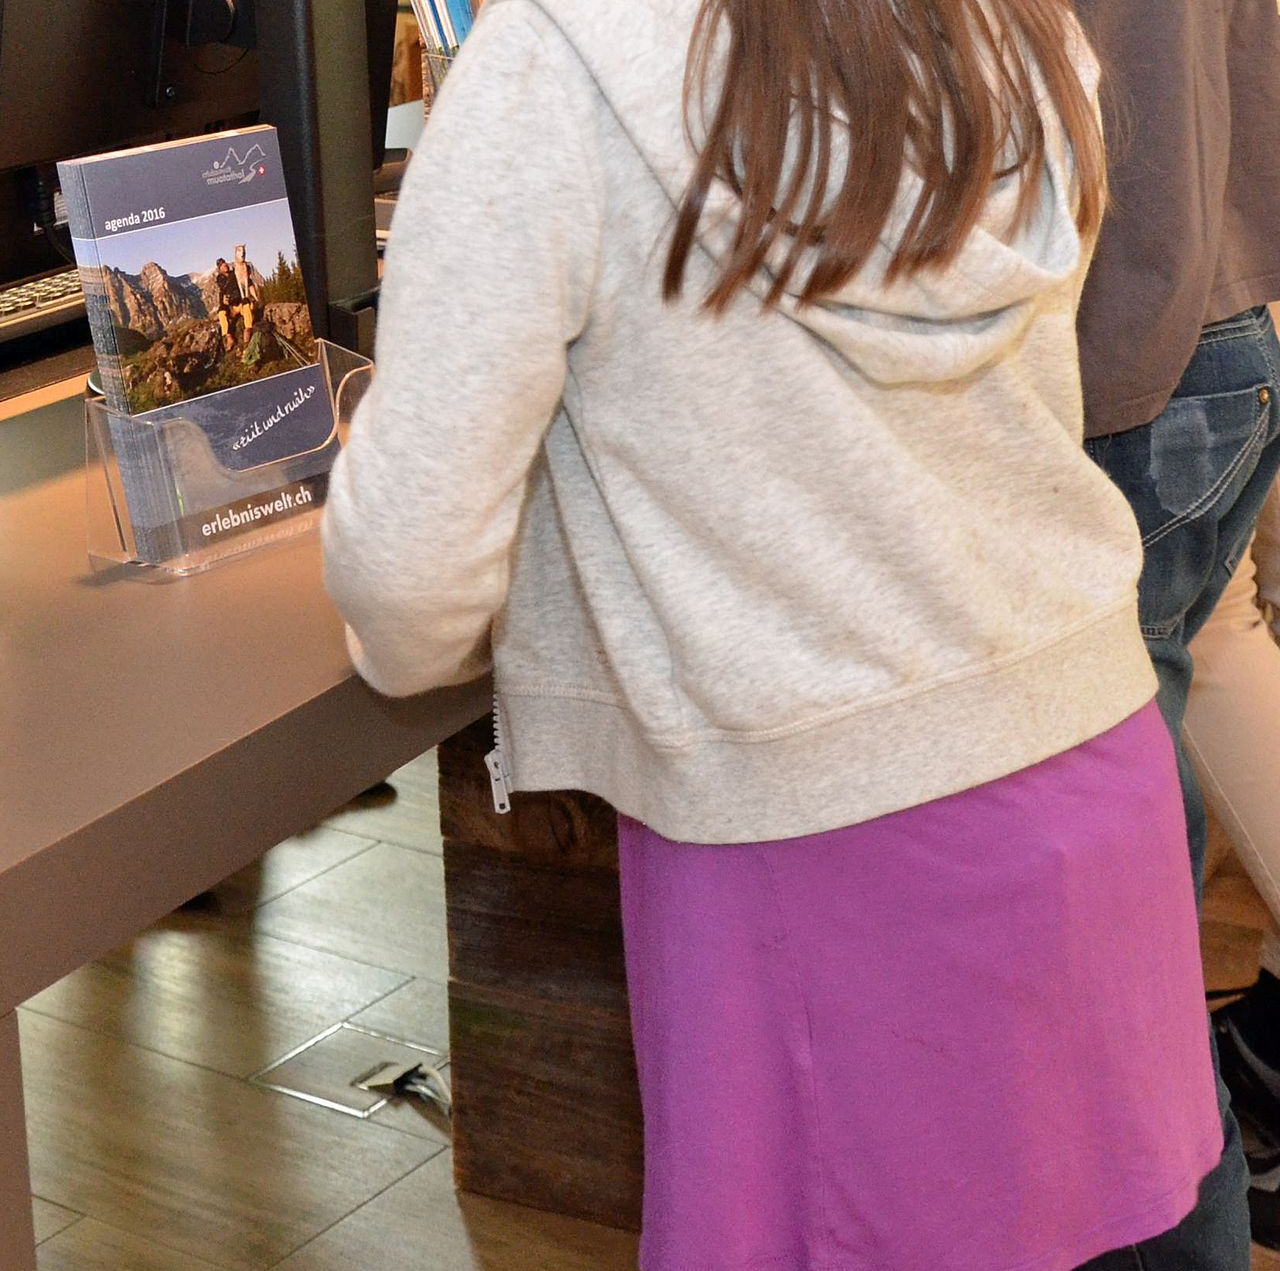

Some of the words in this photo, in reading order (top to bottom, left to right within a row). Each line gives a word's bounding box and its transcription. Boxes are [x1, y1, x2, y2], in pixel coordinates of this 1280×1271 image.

[104, 212, 141, 232] agenda
[142, 206, 166, 224] 2016
[201, 485, 313, 539] erlebniswelt.ch
